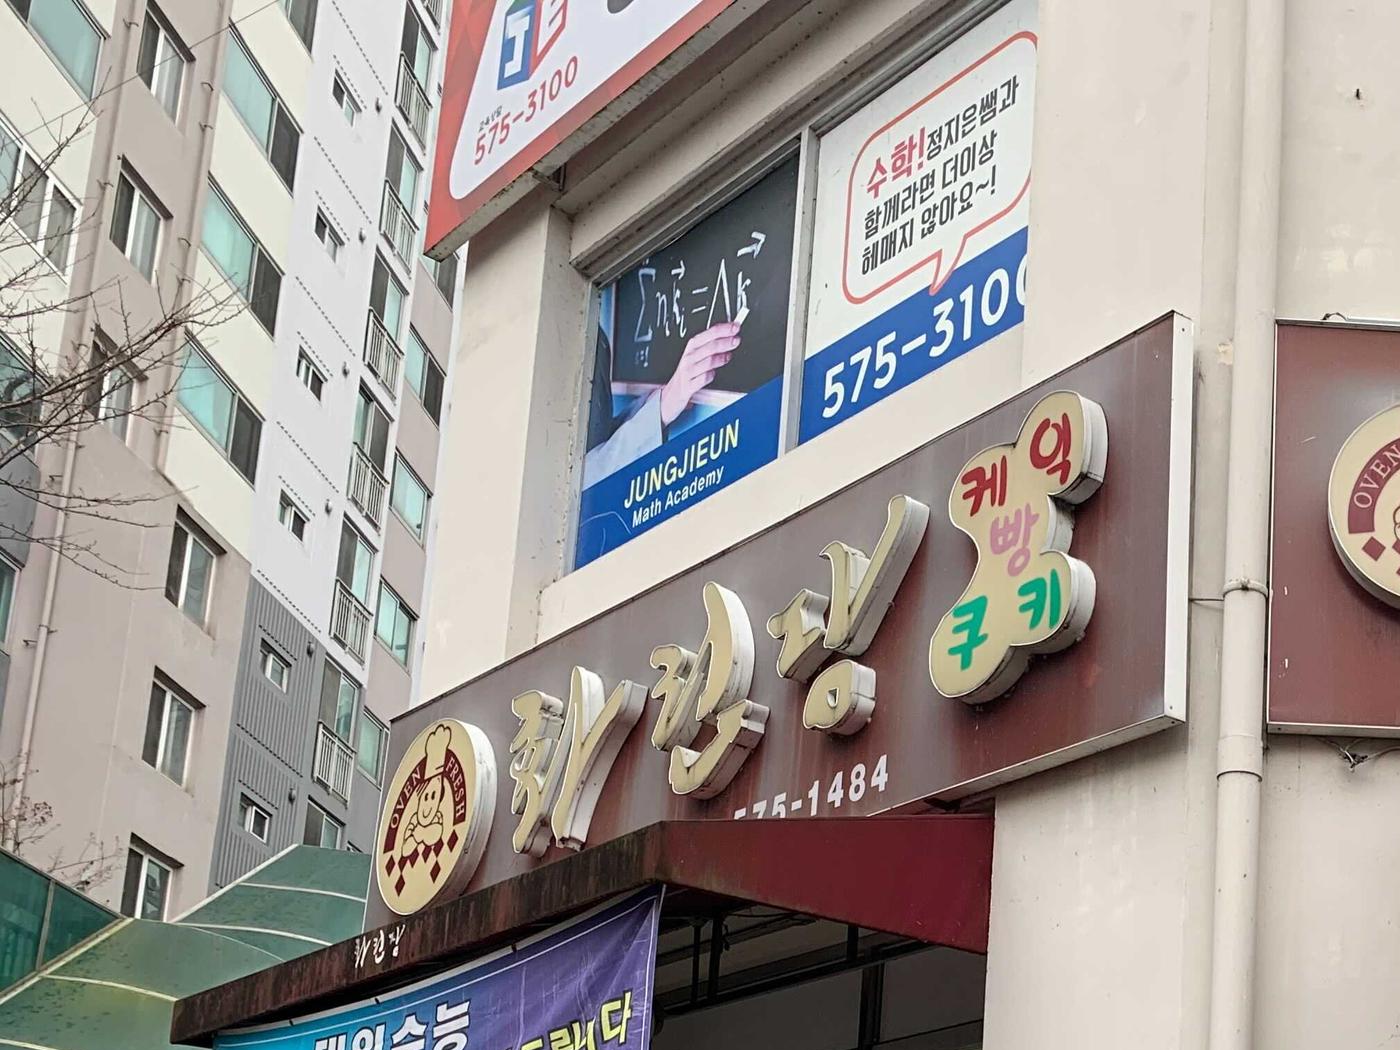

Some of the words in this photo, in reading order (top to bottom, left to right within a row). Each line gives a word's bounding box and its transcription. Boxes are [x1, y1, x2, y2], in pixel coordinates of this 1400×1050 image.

[474, 55, 578, 165] 575-3100
[864, 169, 935, 240] 함께라면
[942, 129, 997, 190] 더이상
[867, 126, 926, 199] 수학!
[861, 217, 914, 275] 헤매지
[624, 419, 739, 509] JUNGJIEUN
[632, 498, 662, 528] Math
[665, 465, 724, 510] Academy
[961, 412, 1072, 517] 케익
[989, 503, 1040, 575] 빵
[947, 570, 1063, 670] 쿠키
[390, 766, 422, 829] OVEN
[445, 757, 466, 818] FRESH
